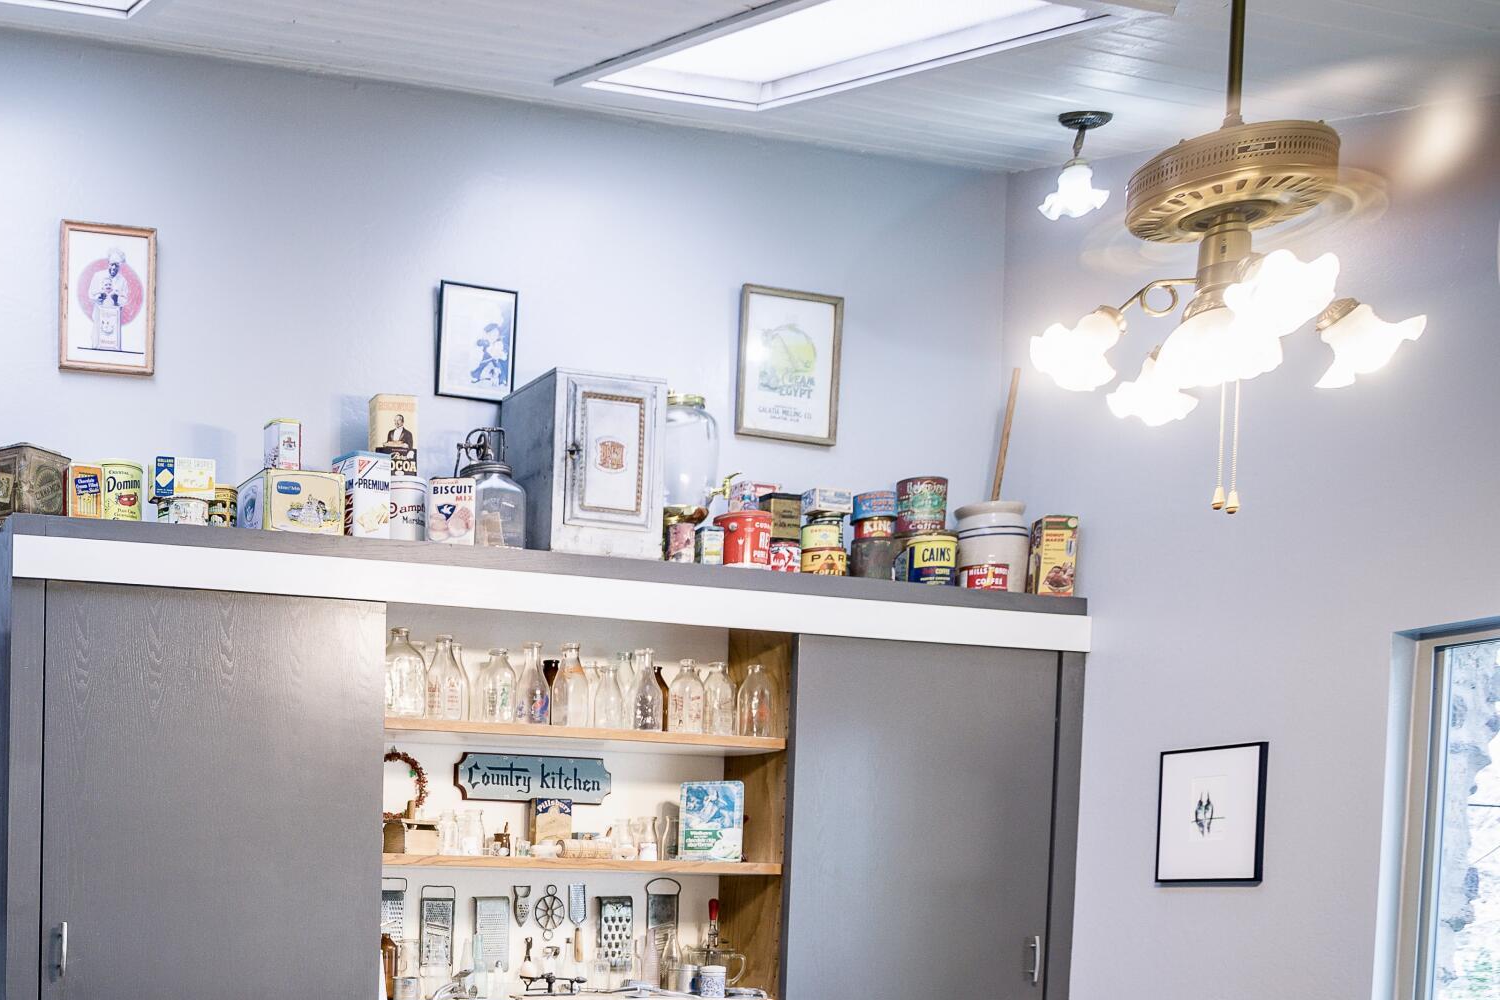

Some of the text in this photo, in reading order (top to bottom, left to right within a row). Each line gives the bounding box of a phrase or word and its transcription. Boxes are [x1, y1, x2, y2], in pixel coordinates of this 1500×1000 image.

[391, 461, 417, 472] OCOA
[357, 478, 390, 492] PREMIUM
[433, 485, 473, 495] BISCUIT
[467, 761, 601, 793] Country kitchen
[537, 799, 571, 814] Pillsbury
